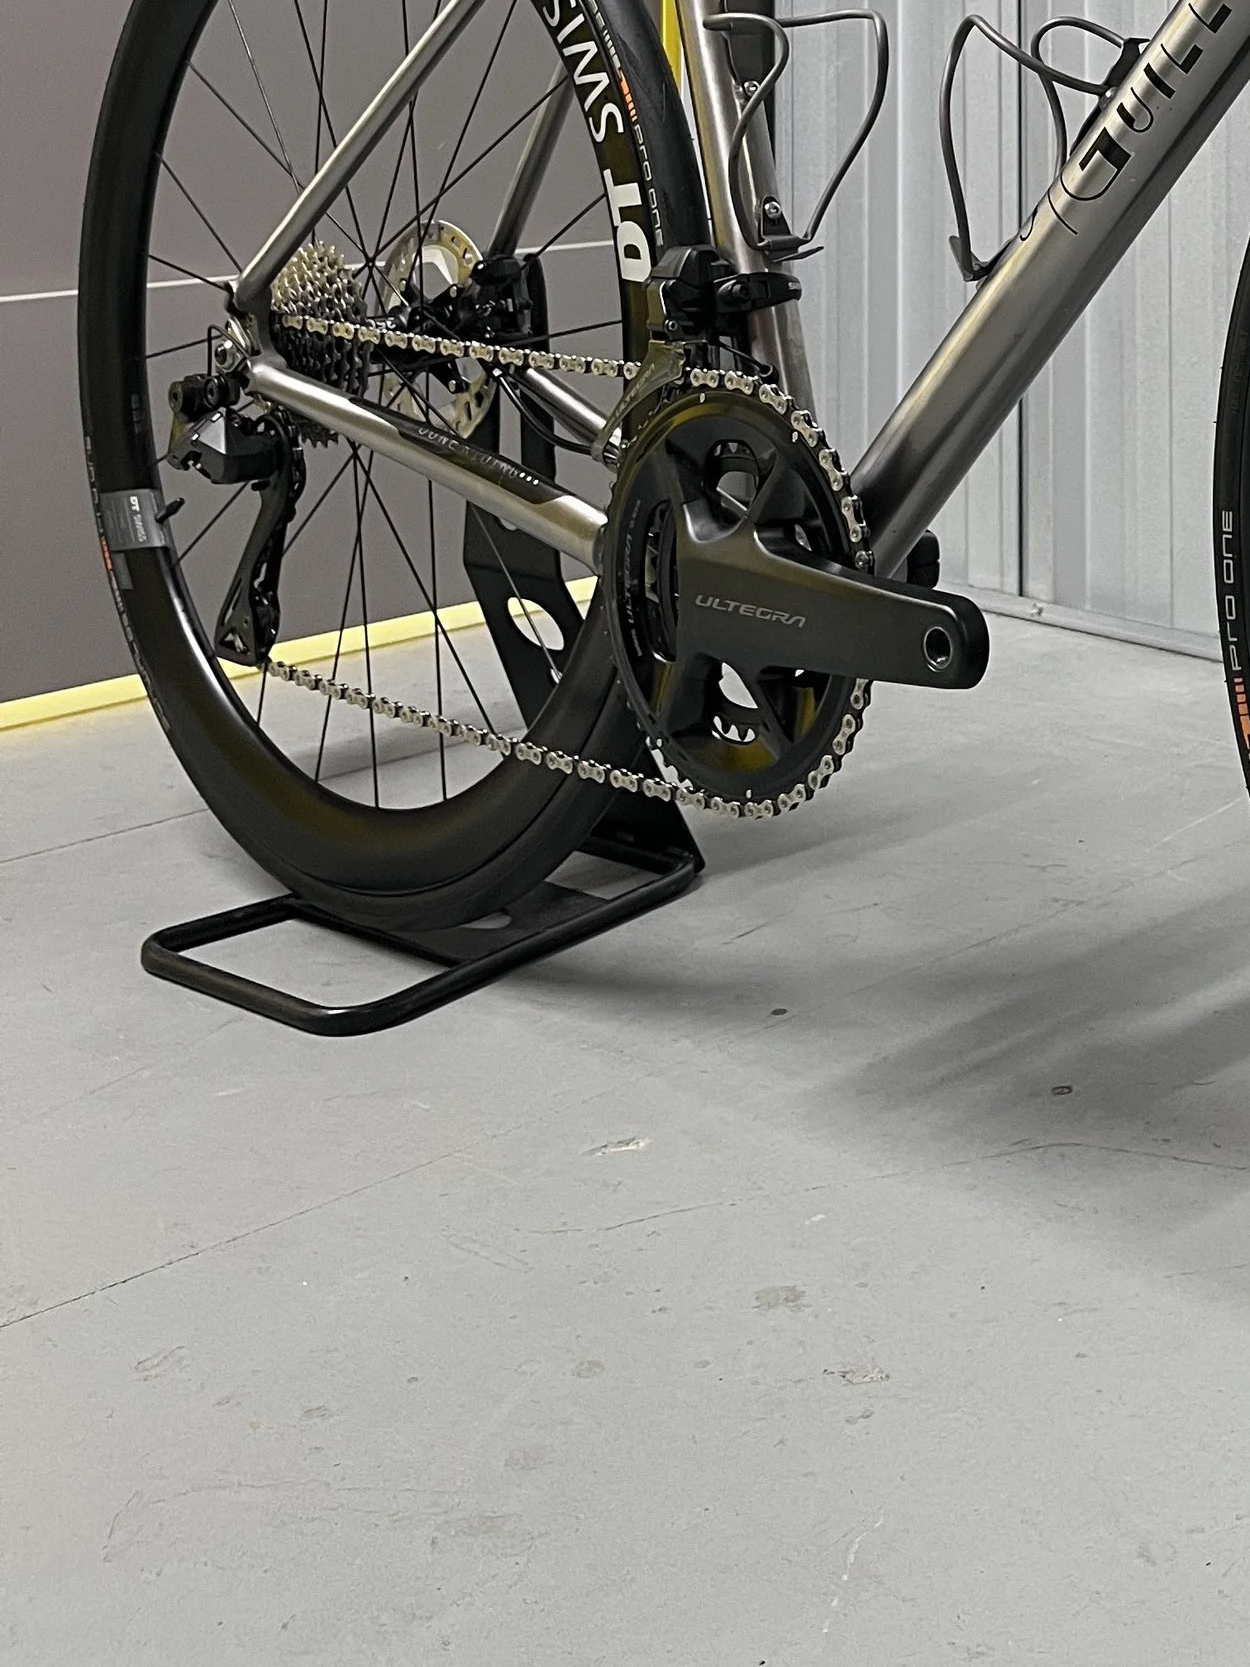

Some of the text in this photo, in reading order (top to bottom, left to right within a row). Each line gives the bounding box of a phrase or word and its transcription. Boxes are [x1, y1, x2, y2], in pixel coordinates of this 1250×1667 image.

[603, 168, 652, 282] DT
[129, 495, 140, 513] DT
[1221, 509, 1235, 585] ONE
[695, 594, 807, 628] ULTEGRA
